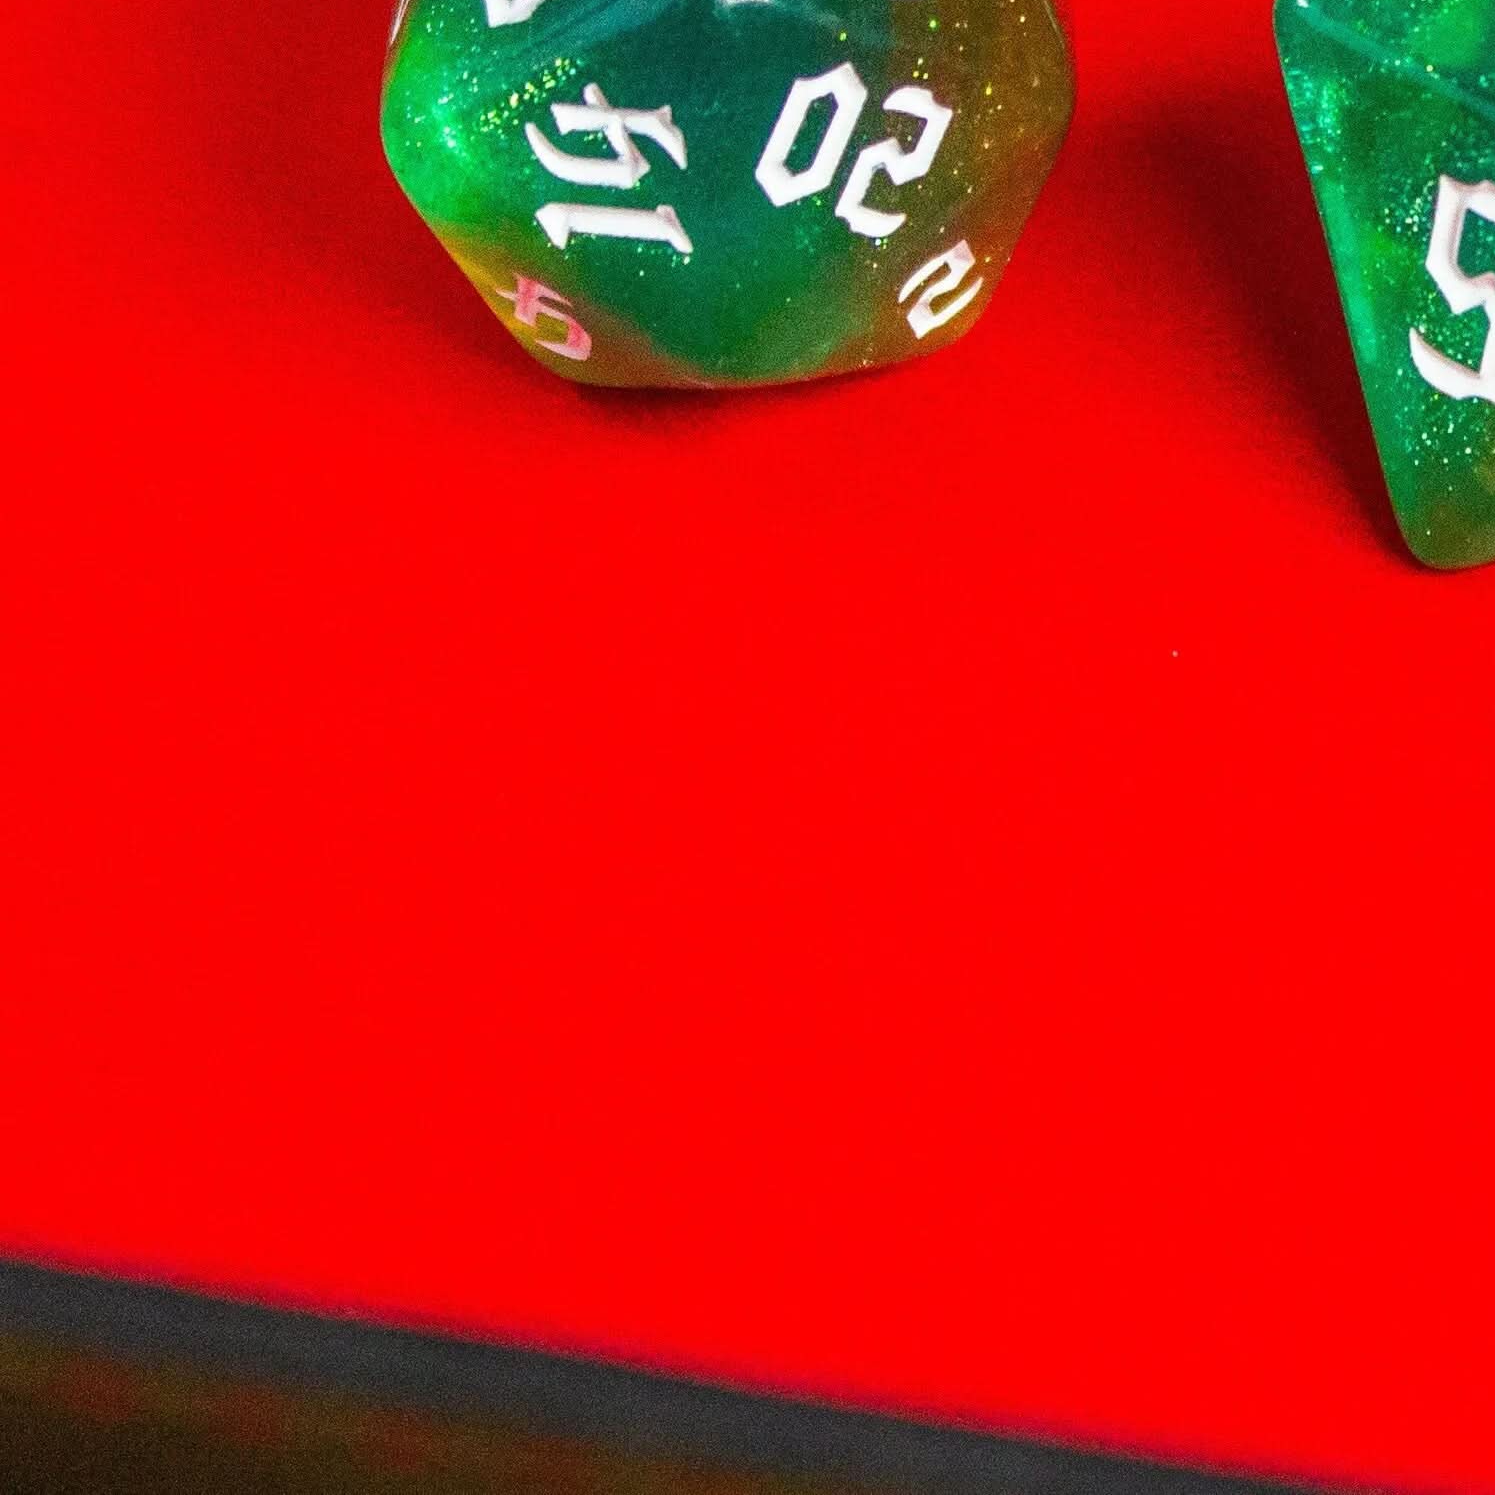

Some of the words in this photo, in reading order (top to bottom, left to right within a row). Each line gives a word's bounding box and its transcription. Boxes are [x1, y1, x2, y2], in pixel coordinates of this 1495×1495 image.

[523, 82, 694, 255] 14
[753, 60, 955, 239] 20
[897, 238, 984, 340] 2
